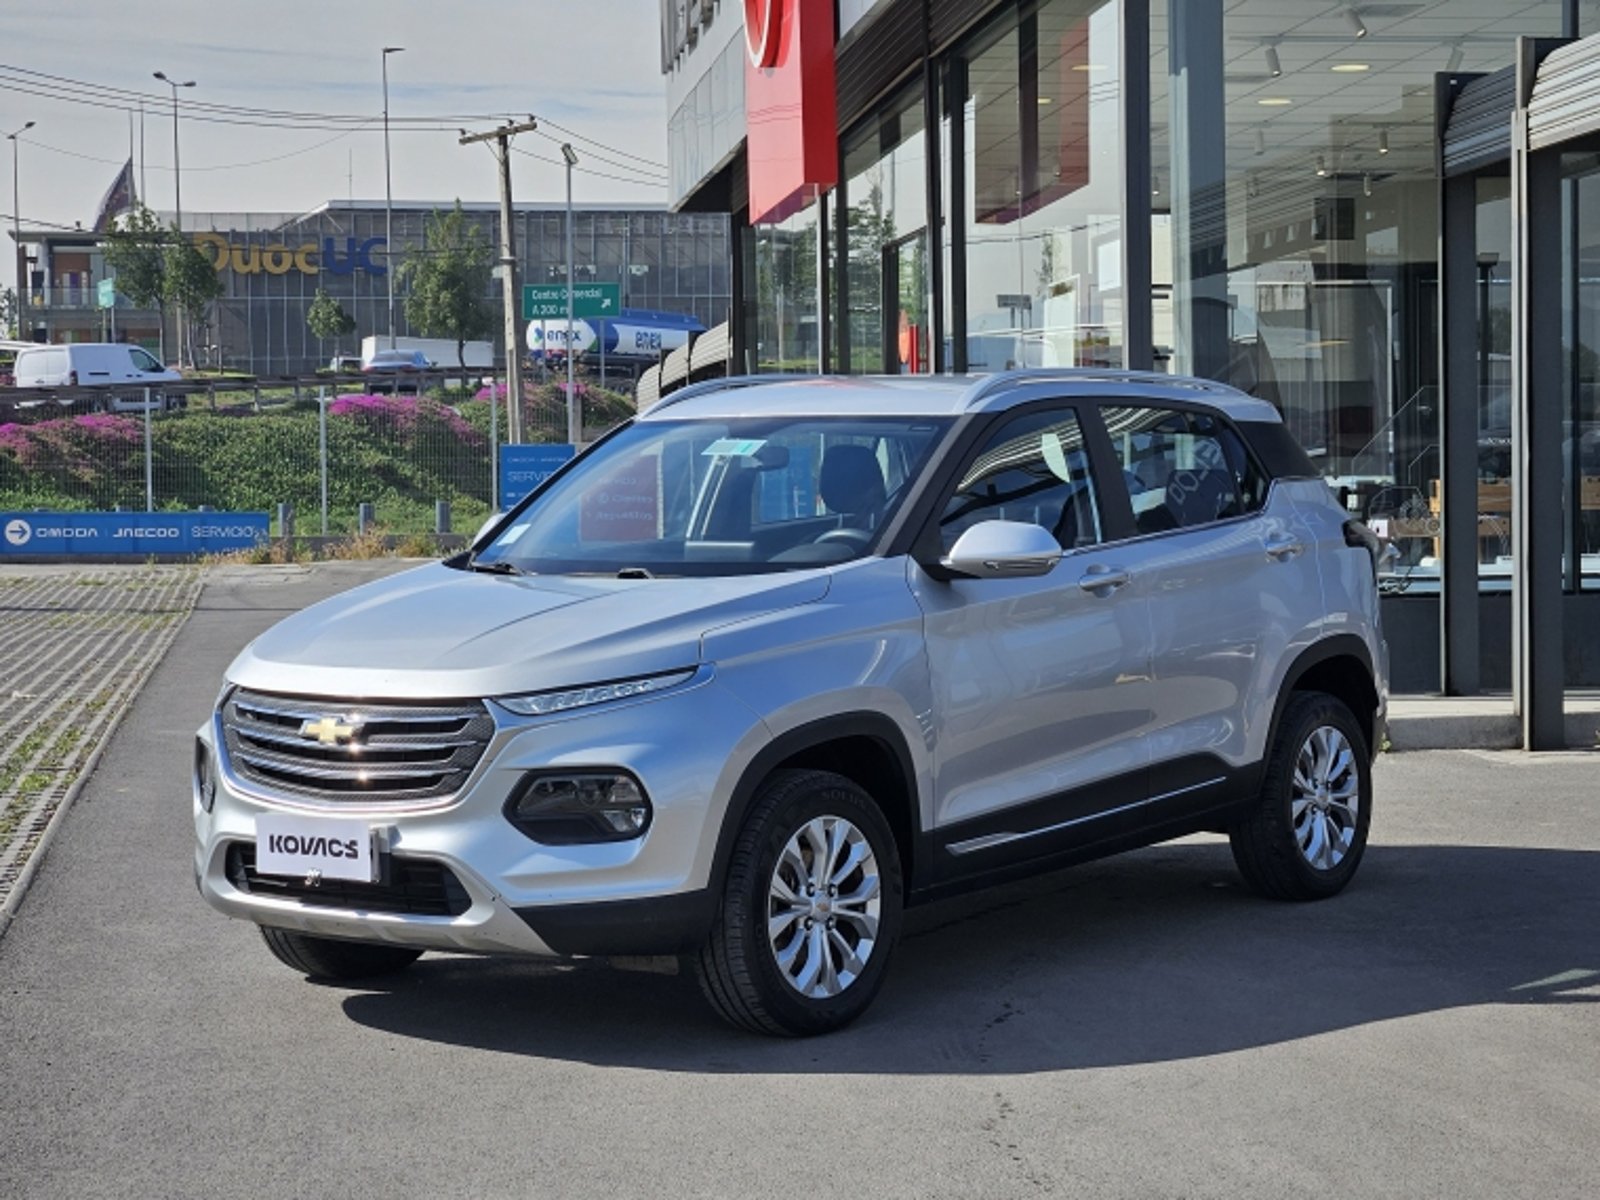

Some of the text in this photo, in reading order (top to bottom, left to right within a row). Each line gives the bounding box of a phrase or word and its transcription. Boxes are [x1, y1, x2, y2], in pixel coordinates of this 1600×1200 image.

[35, 527, 98, 538] OMODA
[112, 527, 180, 538] JAECOO
[269, 834, 359, 860] KOVACS
